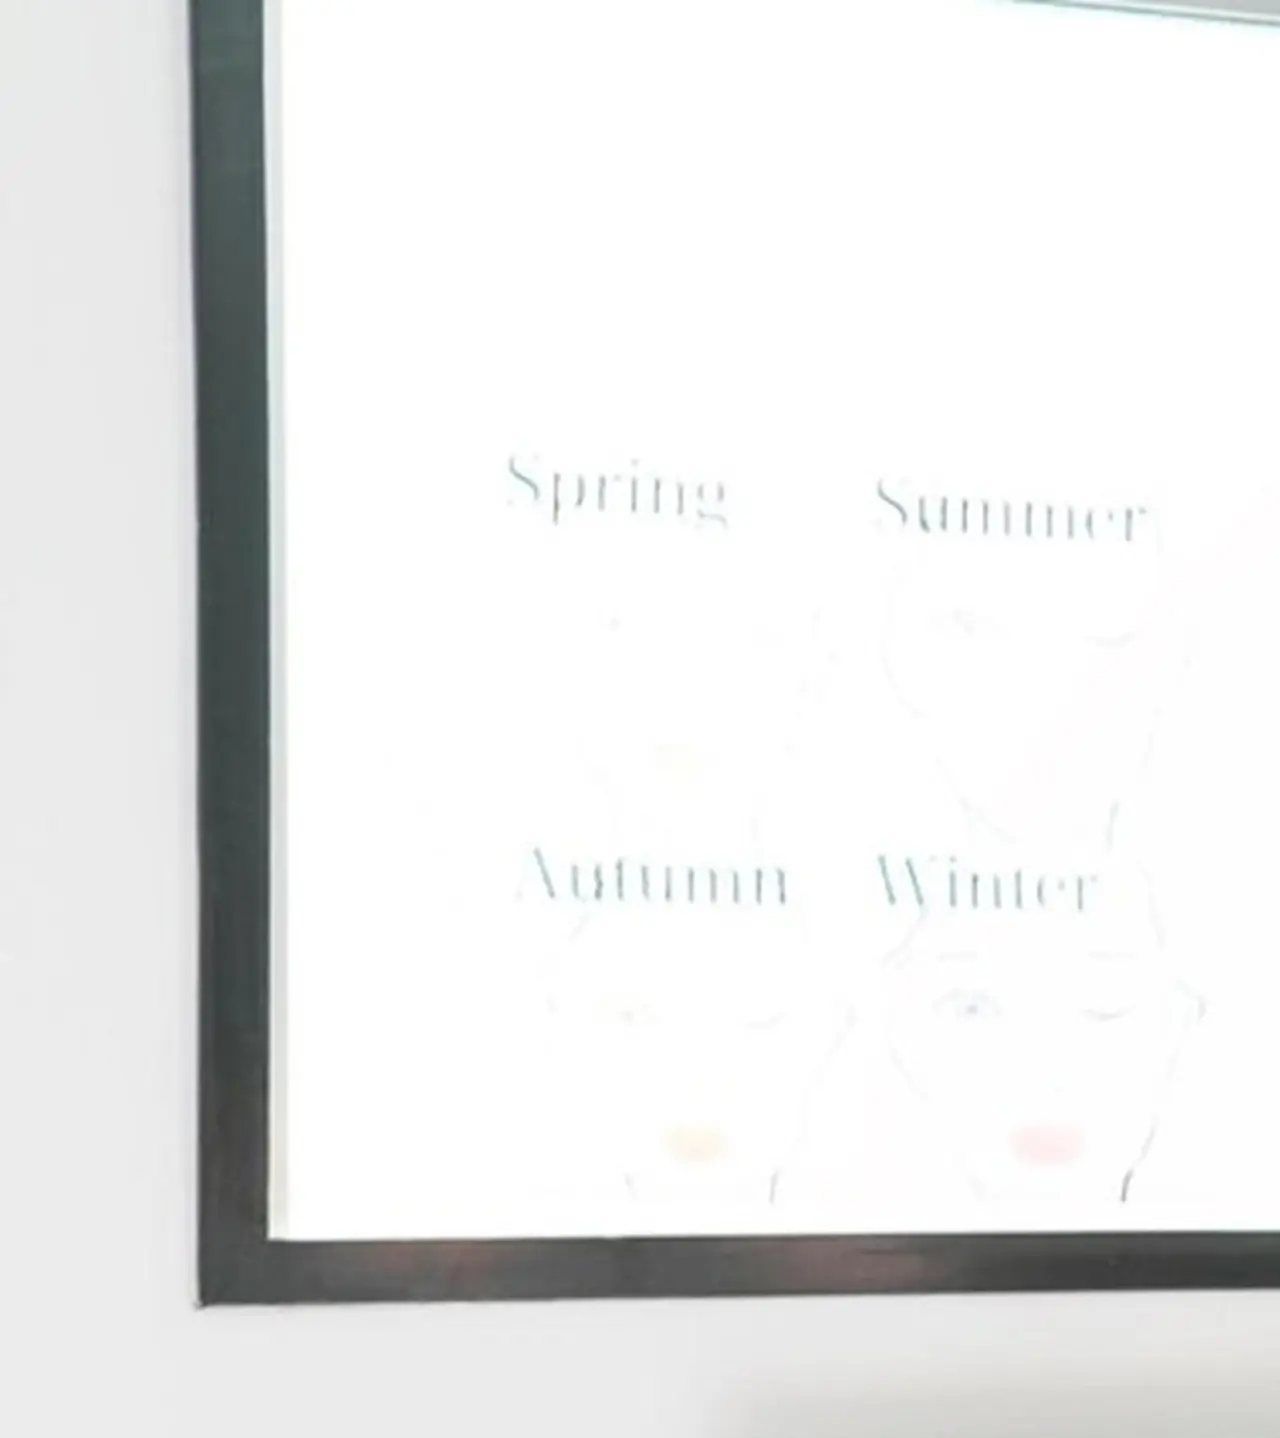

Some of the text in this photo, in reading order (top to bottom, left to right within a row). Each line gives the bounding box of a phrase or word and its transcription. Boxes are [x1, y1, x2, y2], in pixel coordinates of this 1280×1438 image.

[507, 455, 728, 529] Spring
[876, 479, 1148, 542] Summer
[517, 846, 787, 904] Autumn
[877, 854, 1098, 911] Winter
